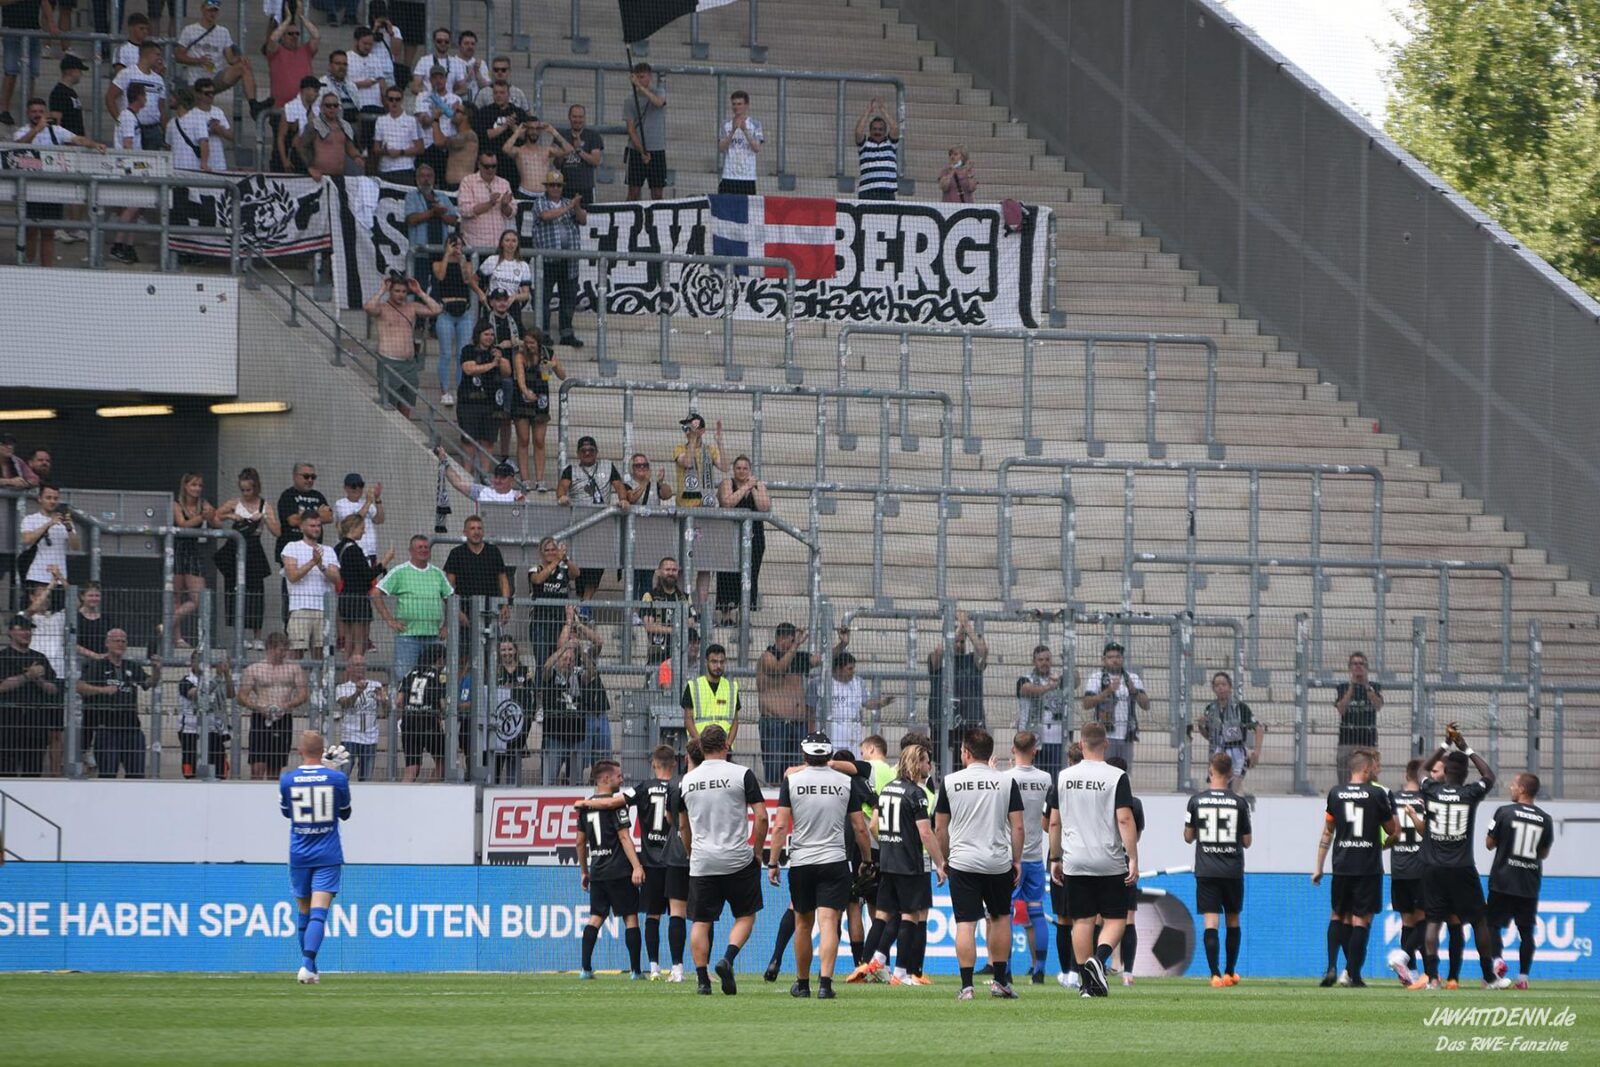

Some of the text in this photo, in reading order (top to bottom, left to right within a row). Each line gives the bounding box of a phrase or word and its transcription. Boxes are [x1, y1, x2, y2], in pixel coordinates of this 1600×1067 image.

[576, 207, 992, 294] ELVBERG
[688, 780, 706, 792] DIE
[796, 785, 817, 796] DIE
[954, 781, 974, 792] DIE
[1065, 780, 1083, 790] DIE
[1198, 798, 1238, 806] NEUBAUER
[1338, 791, 1370, 800] CONRAD
[290, 785, 335, 823] 20
[878, 795, 902, 833] 31
[1344, 801, 1364, 838] 4
[1426, 801, 1470, 837] 30
[1197, 807, 1239, 843] 33
[1511, 820, 1544, 860] 10
[0, 901, 50, 937] SIE
[60, 901, 189, 937] HABEN
[368, 903, 490, 939] GUTEN
